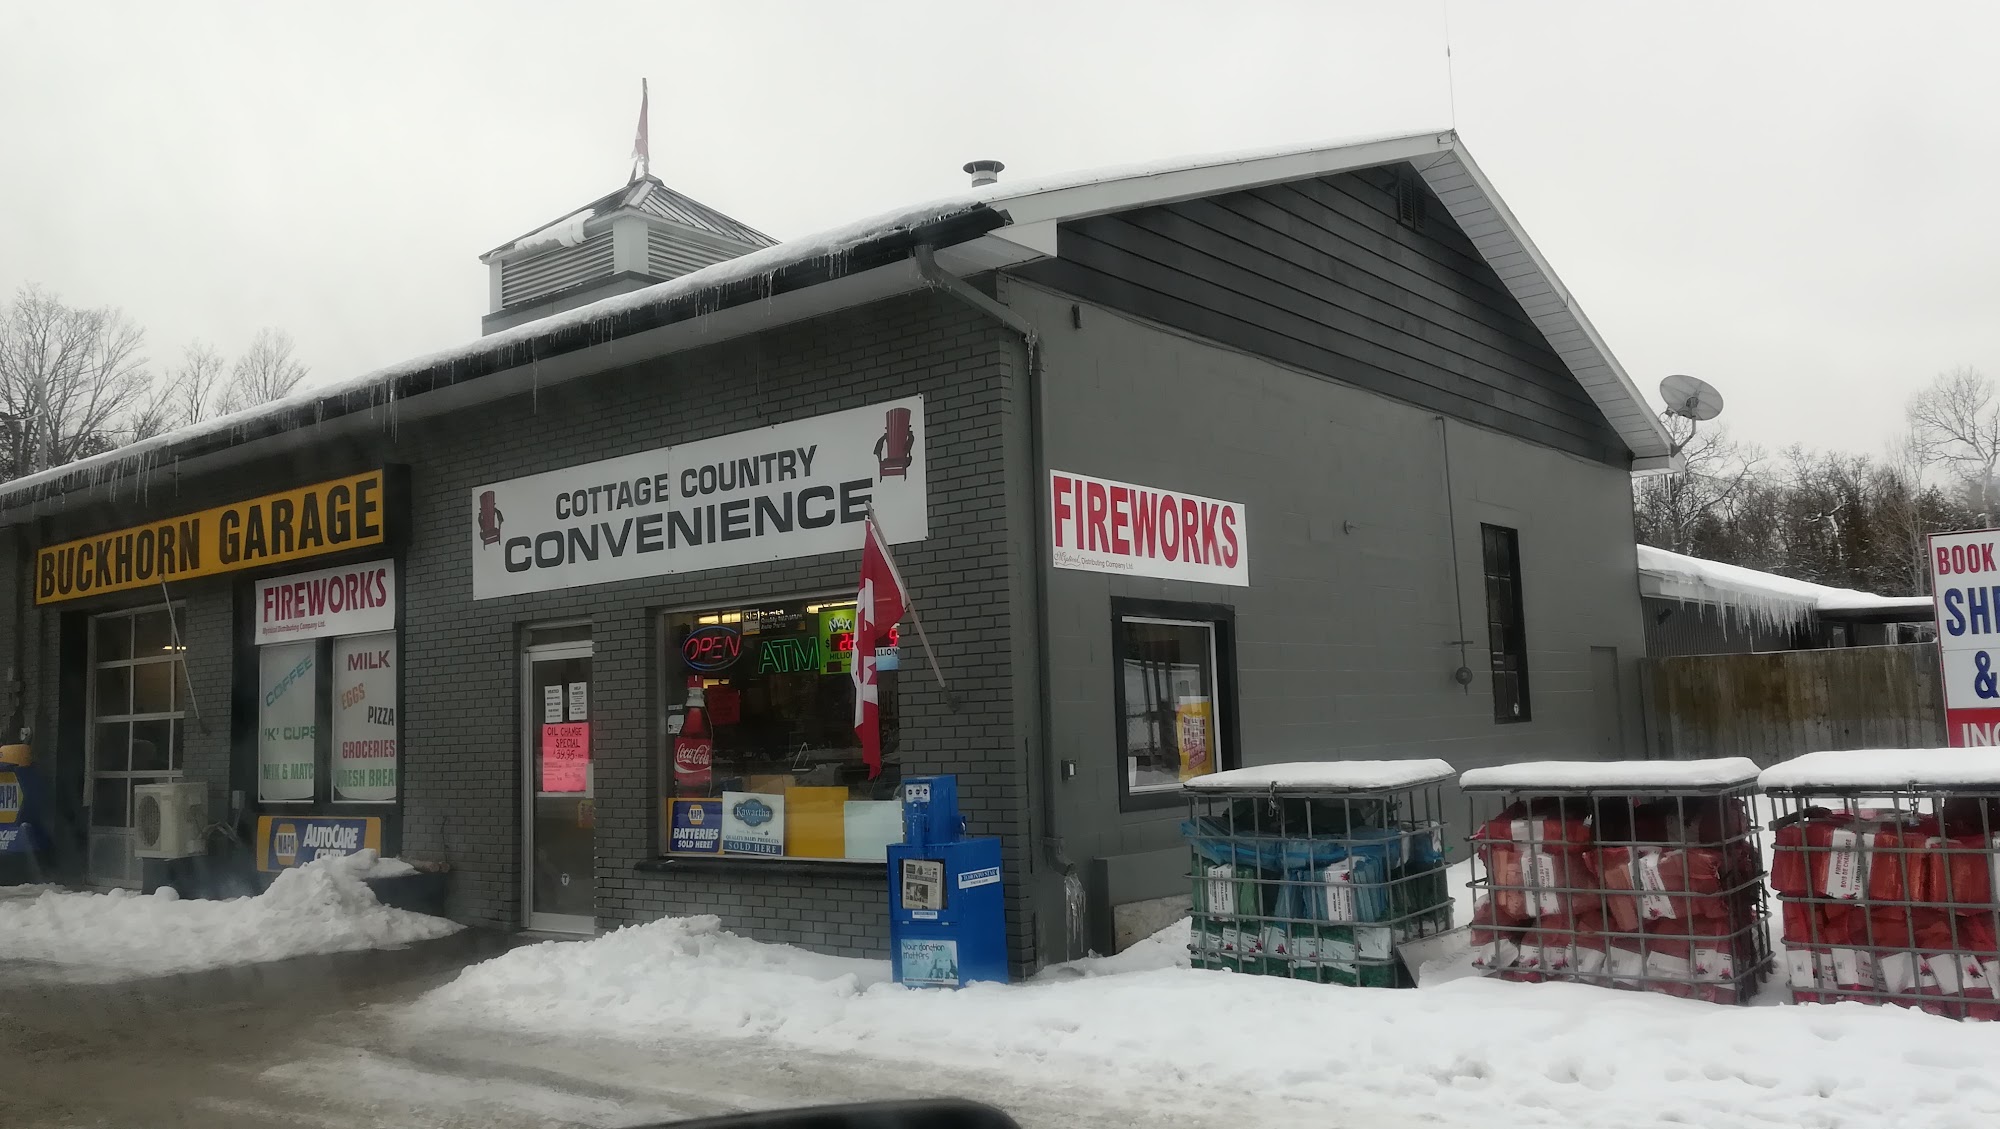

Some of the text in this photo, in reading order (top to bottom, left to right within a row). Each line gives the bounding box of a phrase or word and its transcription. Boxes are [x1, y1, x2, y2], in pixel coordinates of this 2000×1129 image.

[556, 445, 817, 520] COTTAGE COUNTRY
[504, 478, 874, 572] CONVENIENCE
[1053, 476, 1238, 569] FIREWORKS
[40, 478, 380, 598] BUCKHORN GARAGE
[1106, 560, 1126, 570] Company
[1936, 543, 1997, 575] BOOK
[263, 568, 387, 622] FIREWORKS
[829, 617, 852, 632] MAX
[684, 635, 741, 660] OPEN
[758, 636, 819, 675] ATM
[347, 650, 390, 671] MILK
[265, 655, 313, 707] COFFEE
[1975, 650, 2000, 699] &
[341, 682, 365, 711] EGGS
[367, 705, 394, 727] PIZZA
[284, 725, 317, 740] CUPS
[546, 727, 583, 737] OIL CHANGE
[343, 740, 395, 759] GROCERIES
[555, 738, 581, 748] SPECIAL
[676, 743, 710, 765] Coca-Cola
[290, 762, 314, 780] MATC
[736, 806, 770, 818] Kawartha
[277, 834, 296, 854] NAPA
[673, 828, 719, 840] BATTERIES
[677, 840, 713, 849] SOLD HERE!
[728, 841, 777, 853] SOLD HERE
[902, 942, 945, 953] Your donation
[903, 952, 930, 960] matters
